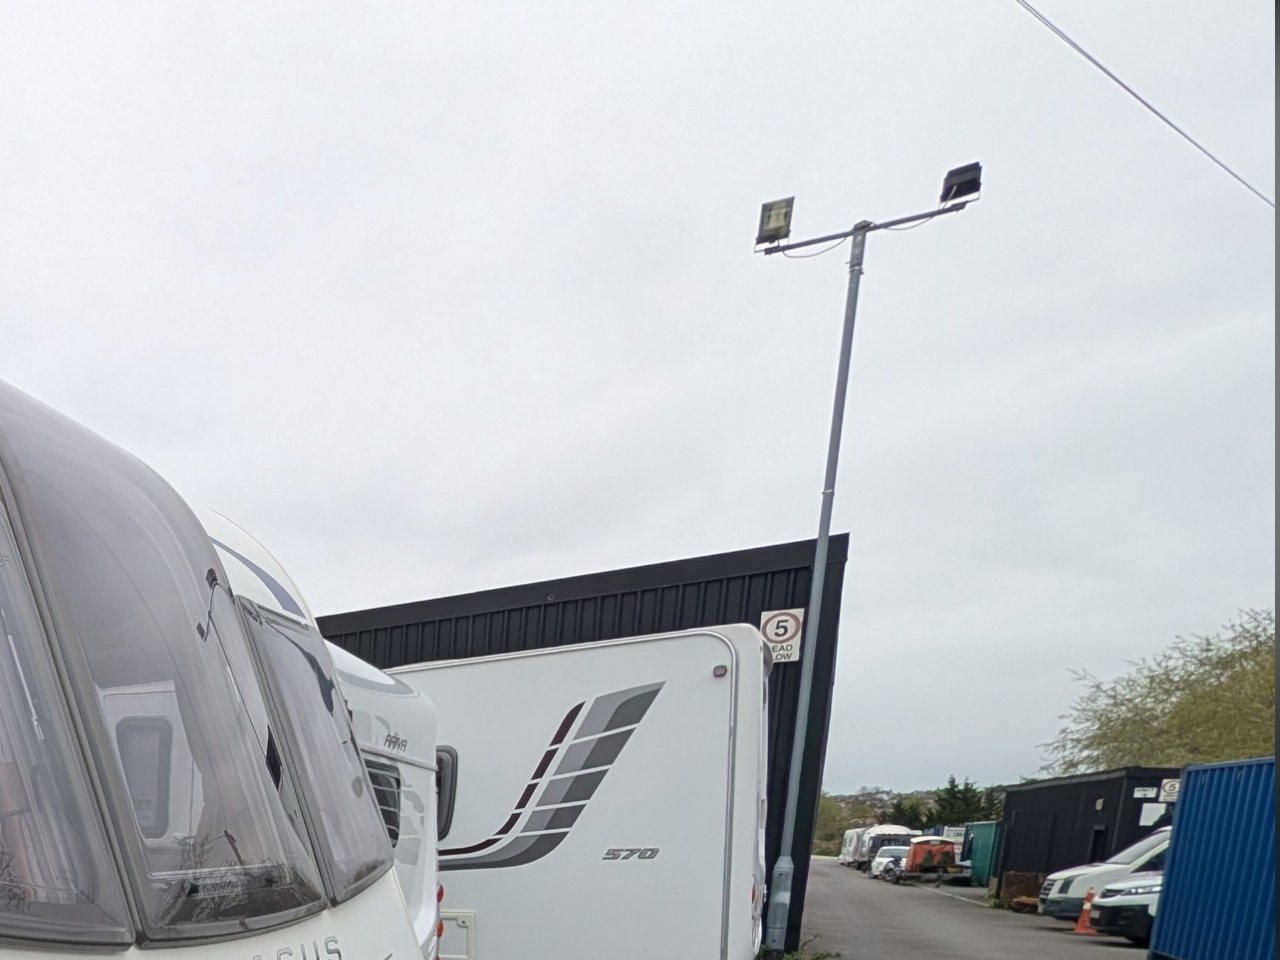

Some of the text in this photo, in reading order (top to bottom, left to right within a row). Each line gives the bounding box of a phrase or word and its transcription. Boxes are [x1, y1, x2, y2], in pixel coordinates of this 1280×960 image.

[774, 619, 789, 637] 5
[772, 644, 793, 652] EAD
[773, 653, 793, 661] OW
[602, 848, 660, 860] 570
